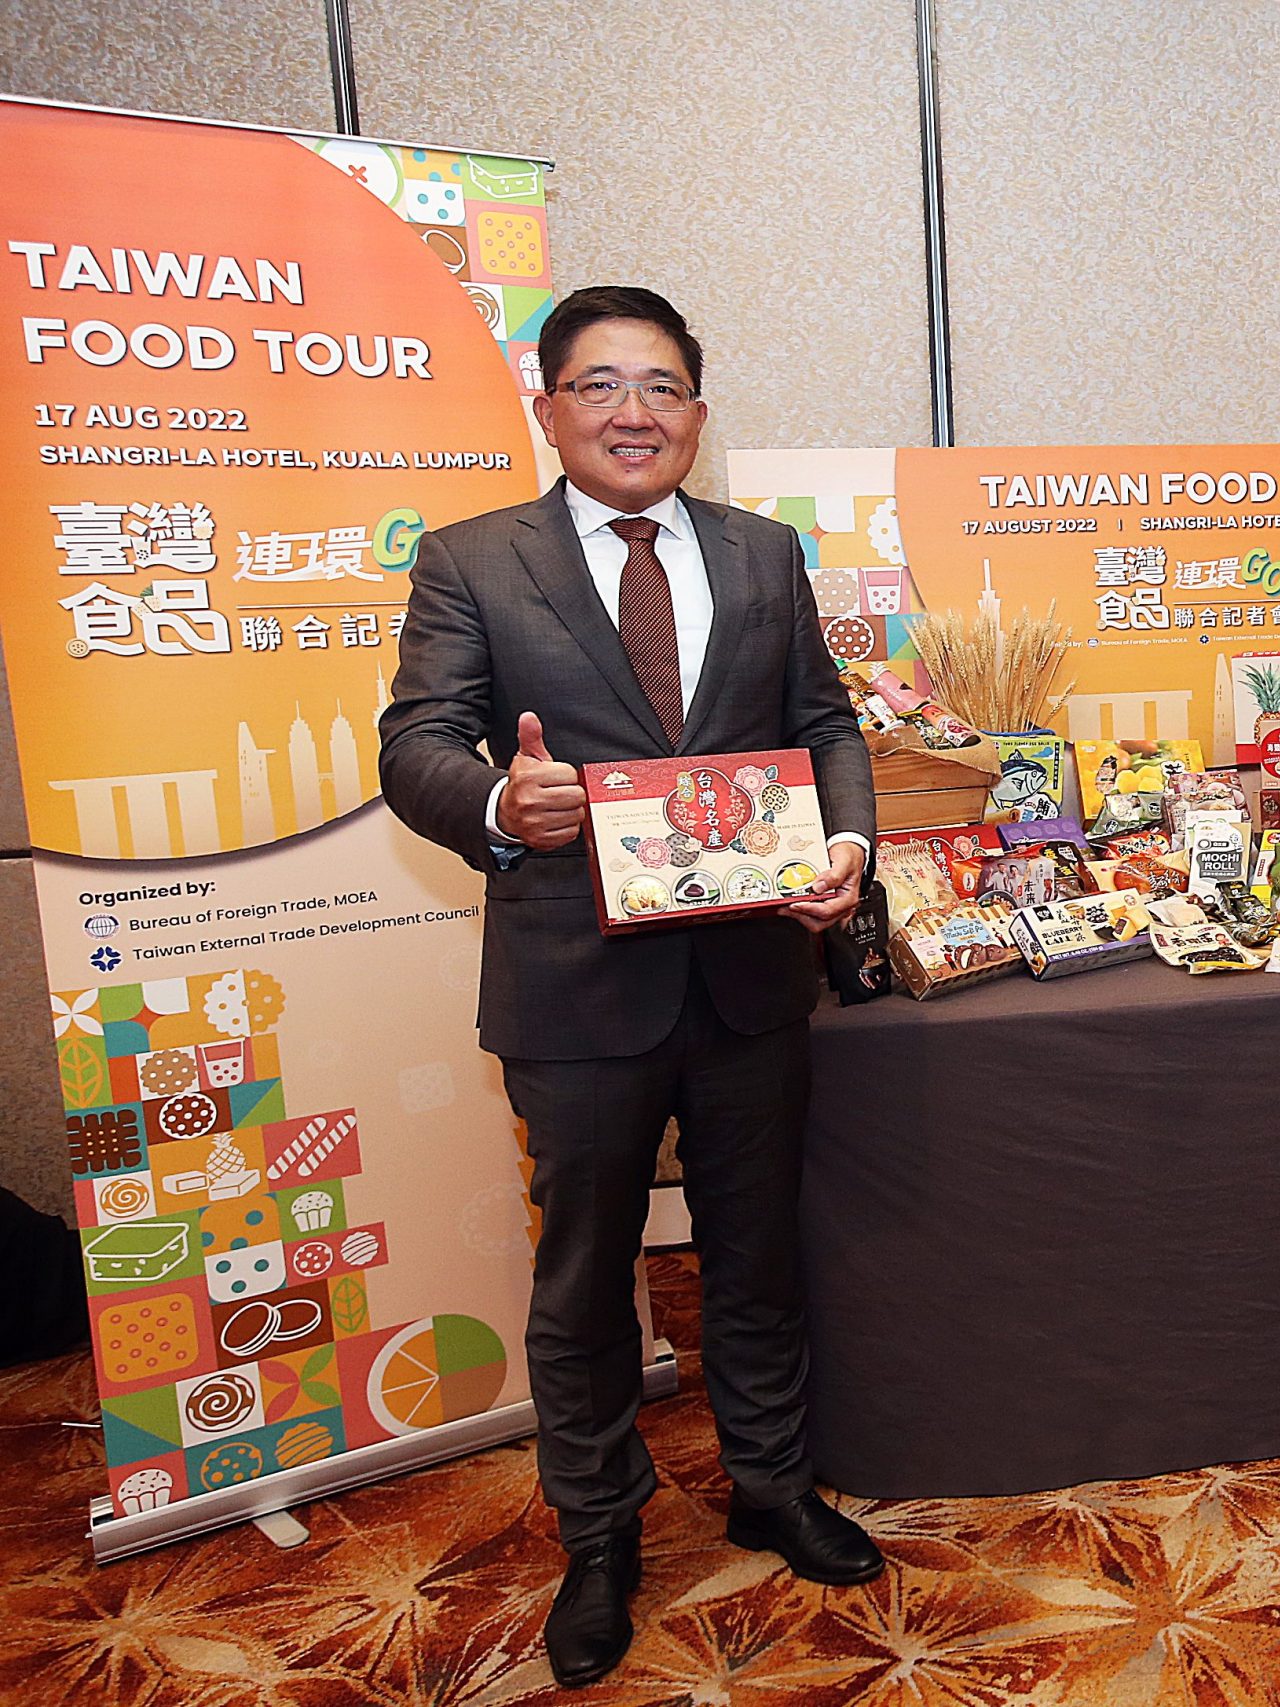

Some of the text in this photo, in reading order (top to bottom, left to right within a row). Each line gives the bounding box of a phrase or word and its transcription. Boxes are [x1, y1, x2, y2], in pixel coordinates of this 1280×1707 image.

[8, 240, 304, 304] TAIWAN
[22, 316, 432, 379] FOOD TOUR
[35, 404, 247, 431] 17 AUG 2022
[39, 445, 511, 471] SHANGRI-LA HOTEL, KUALA LUMPUR
[980, 473, 1149, 509] TAIWAN
[1160, 471, 1278, 505] FOOD
[49, 501, 217, 575] 臺灣
[962, 517, 1097, 534] 17 AUGUST 2022
[1140, 516, 1238, 532] SHANGRI-LA
[1094, 546, 1167, 586] 臺灣
[60, 579, 231, 658] 食品
[1096, 587, 1170, 630] 食品
[240, 612, 406, 651] 聯合記
[696, 772, 724, 847] 台灣名產
[1201, 853, 1240, 862] MOCHI
[1204, 862, 1235, 870] ROLL
[78, 878, 217, 908] Organized by:
[129, 890, 378, 932] Bureau of Foreign Trade, MOEA
[132, 905, 480, 962] Taiwan External Trade Development Council
[1042, 926, 1082, 938] BLUEBERRY
